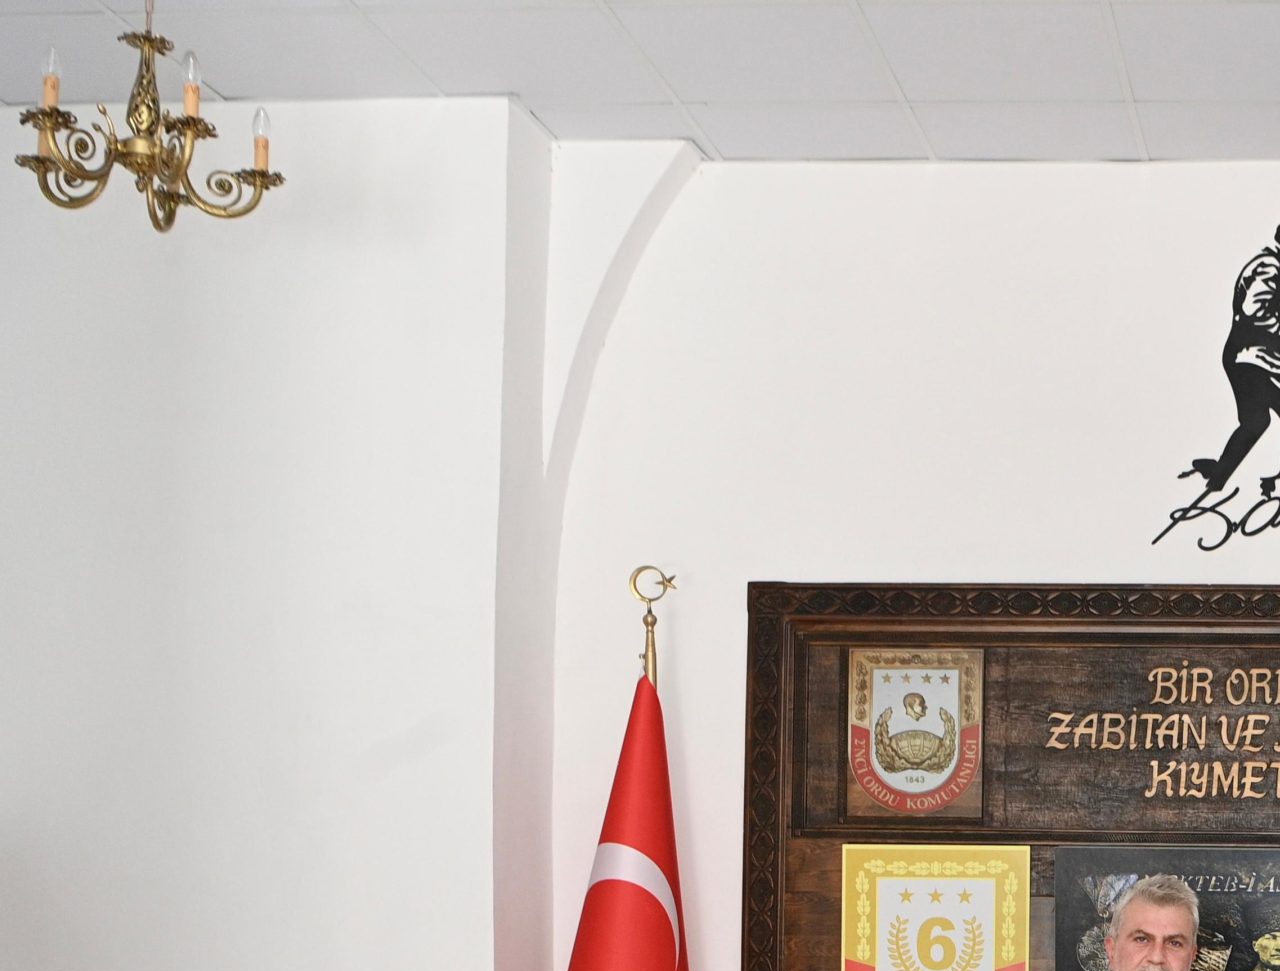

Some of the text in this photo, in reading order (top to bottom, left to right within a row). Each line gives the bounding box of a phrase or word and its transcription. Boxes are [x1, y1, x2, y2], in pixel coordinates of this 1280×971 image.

[1147, 659, 1214, 705] BİR
[1045, 707, 1207, 751] ZABİTAN
[1217, 714, 1271, 752] VE
[863, 775, 900, 807] ORDU
[906, 738, 978, 809] KOMUTANLIĞI
[916, 916, 957, 971] 6
